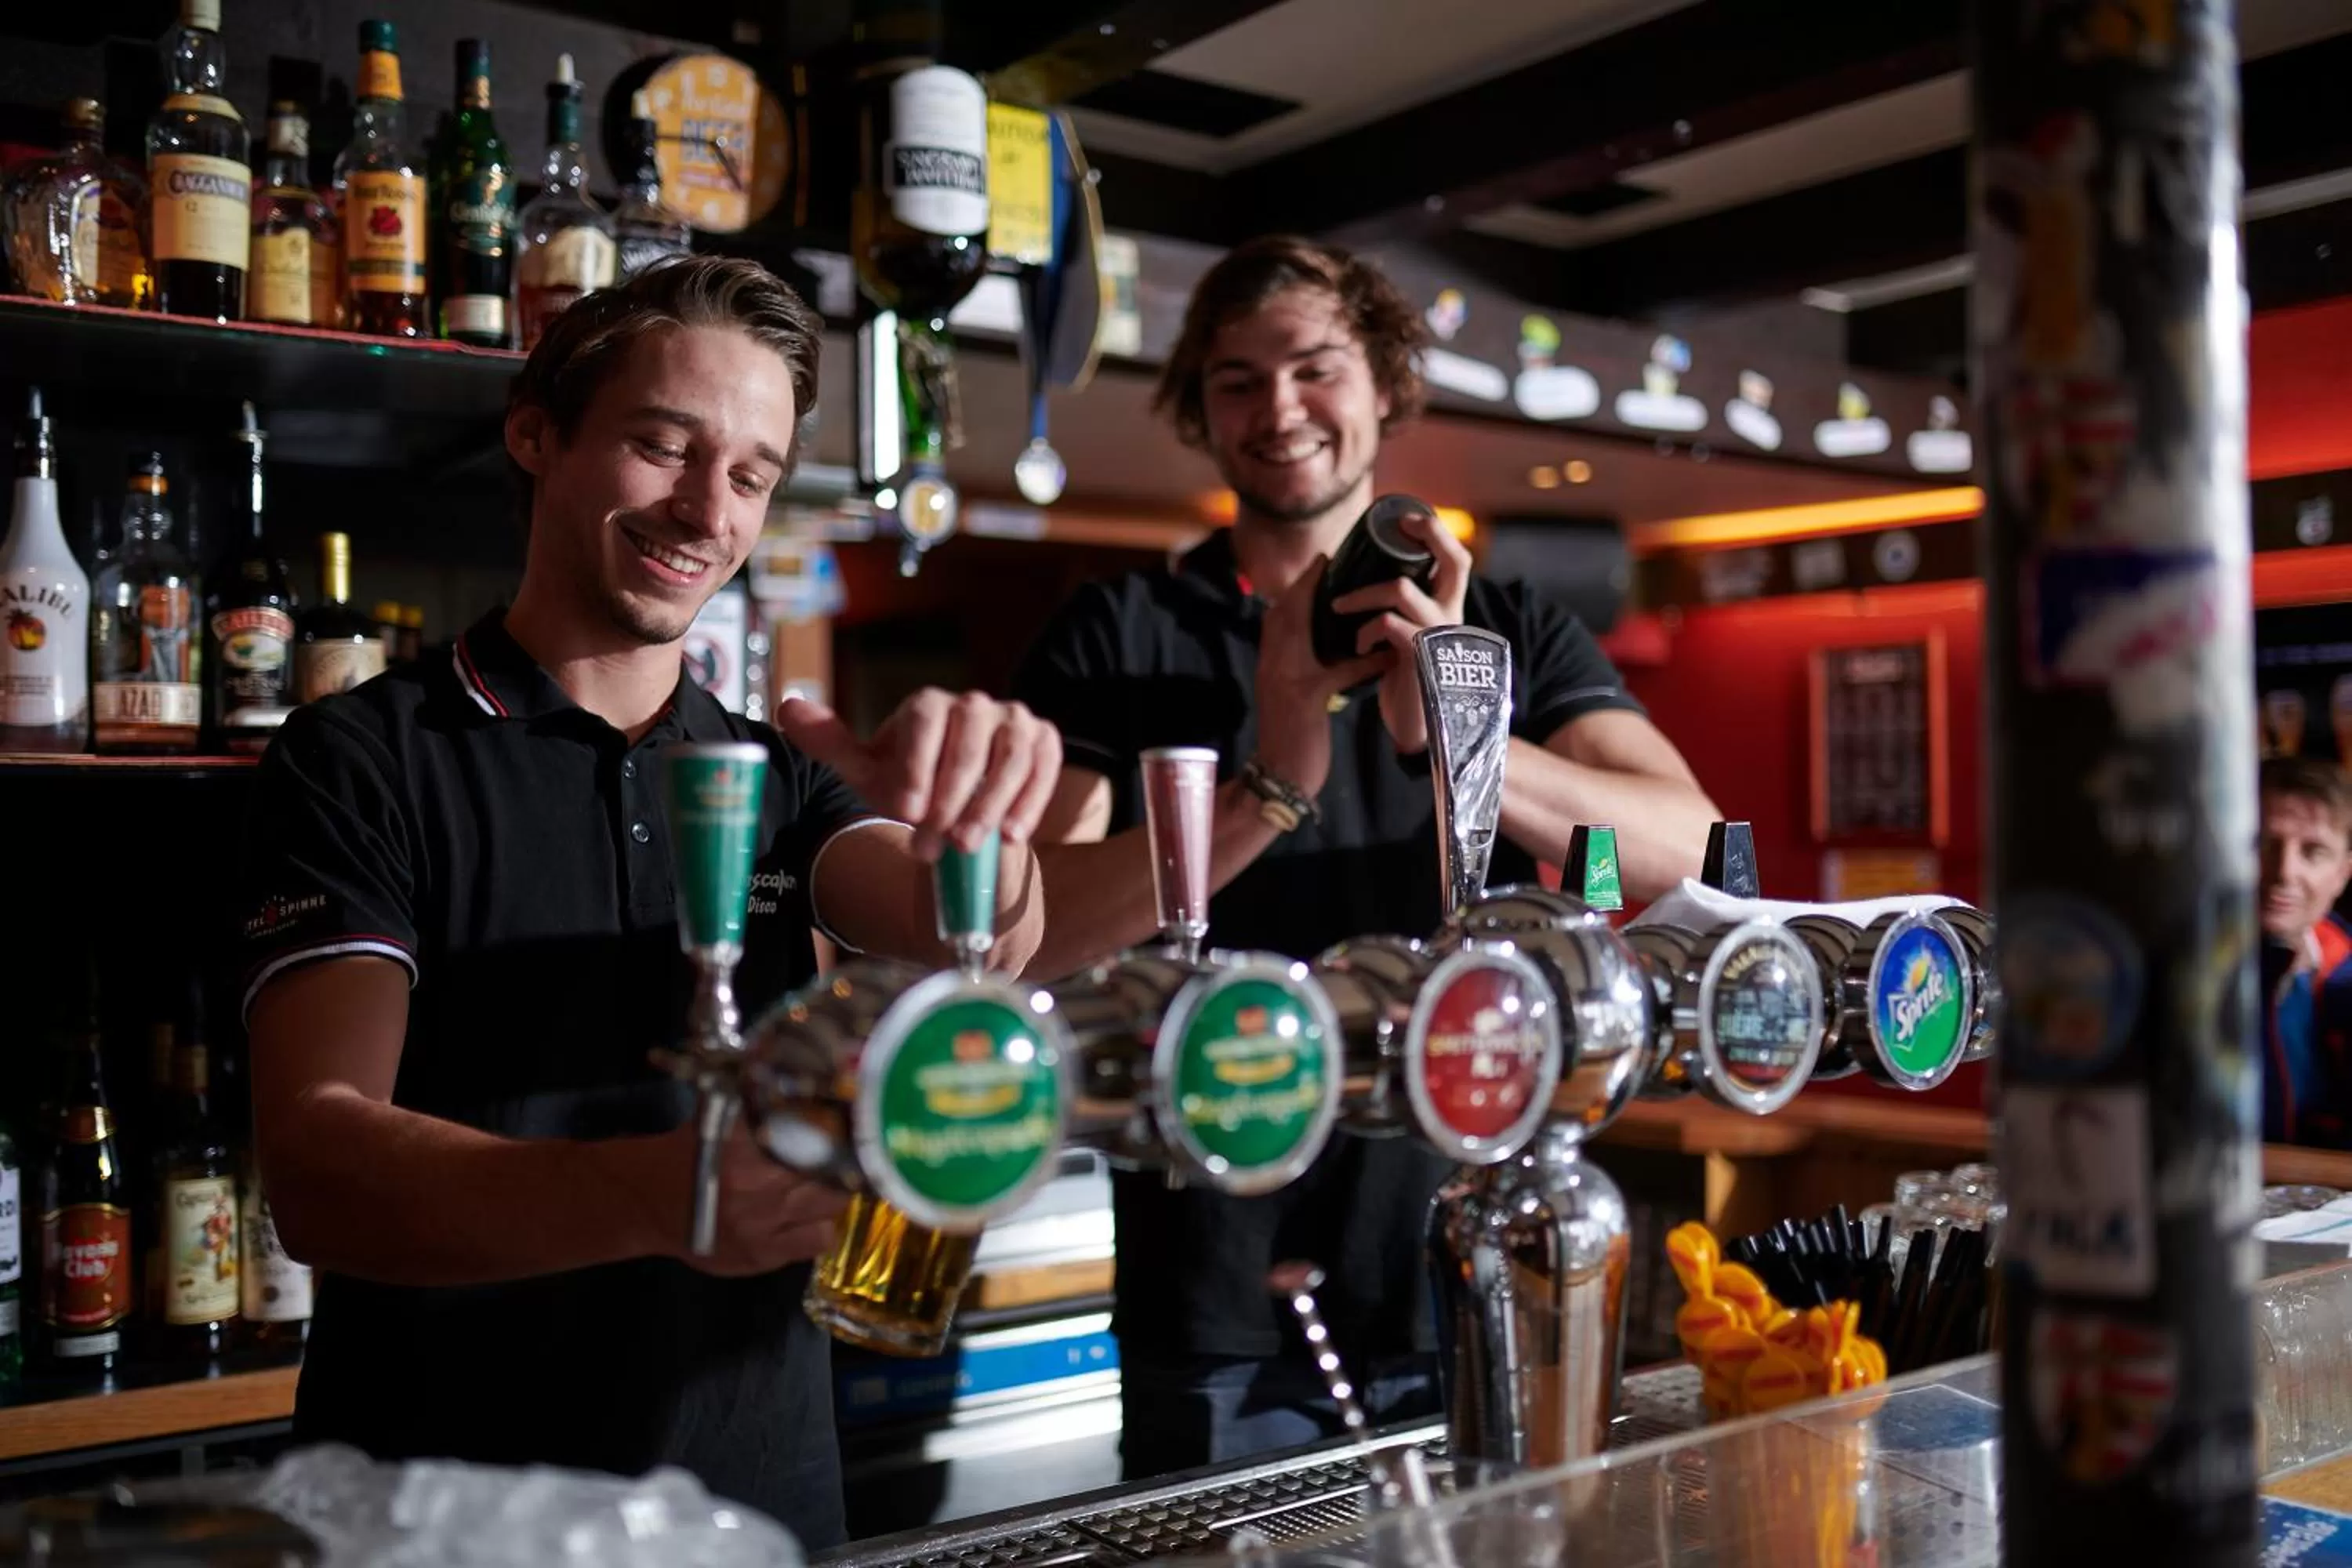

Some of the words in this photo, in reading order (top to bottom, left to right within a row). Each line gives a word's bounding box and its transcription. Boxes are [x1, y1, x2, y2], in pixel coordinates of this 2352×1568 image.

[0, 584, 74, 623] ALIBU
[1436, 642, 1493, 664] SAISON
[1438, 662, 1498, 688] BIER
[747, 895, 777, 914] Disco
[1896, 969, 1944, 1042] Sprite
